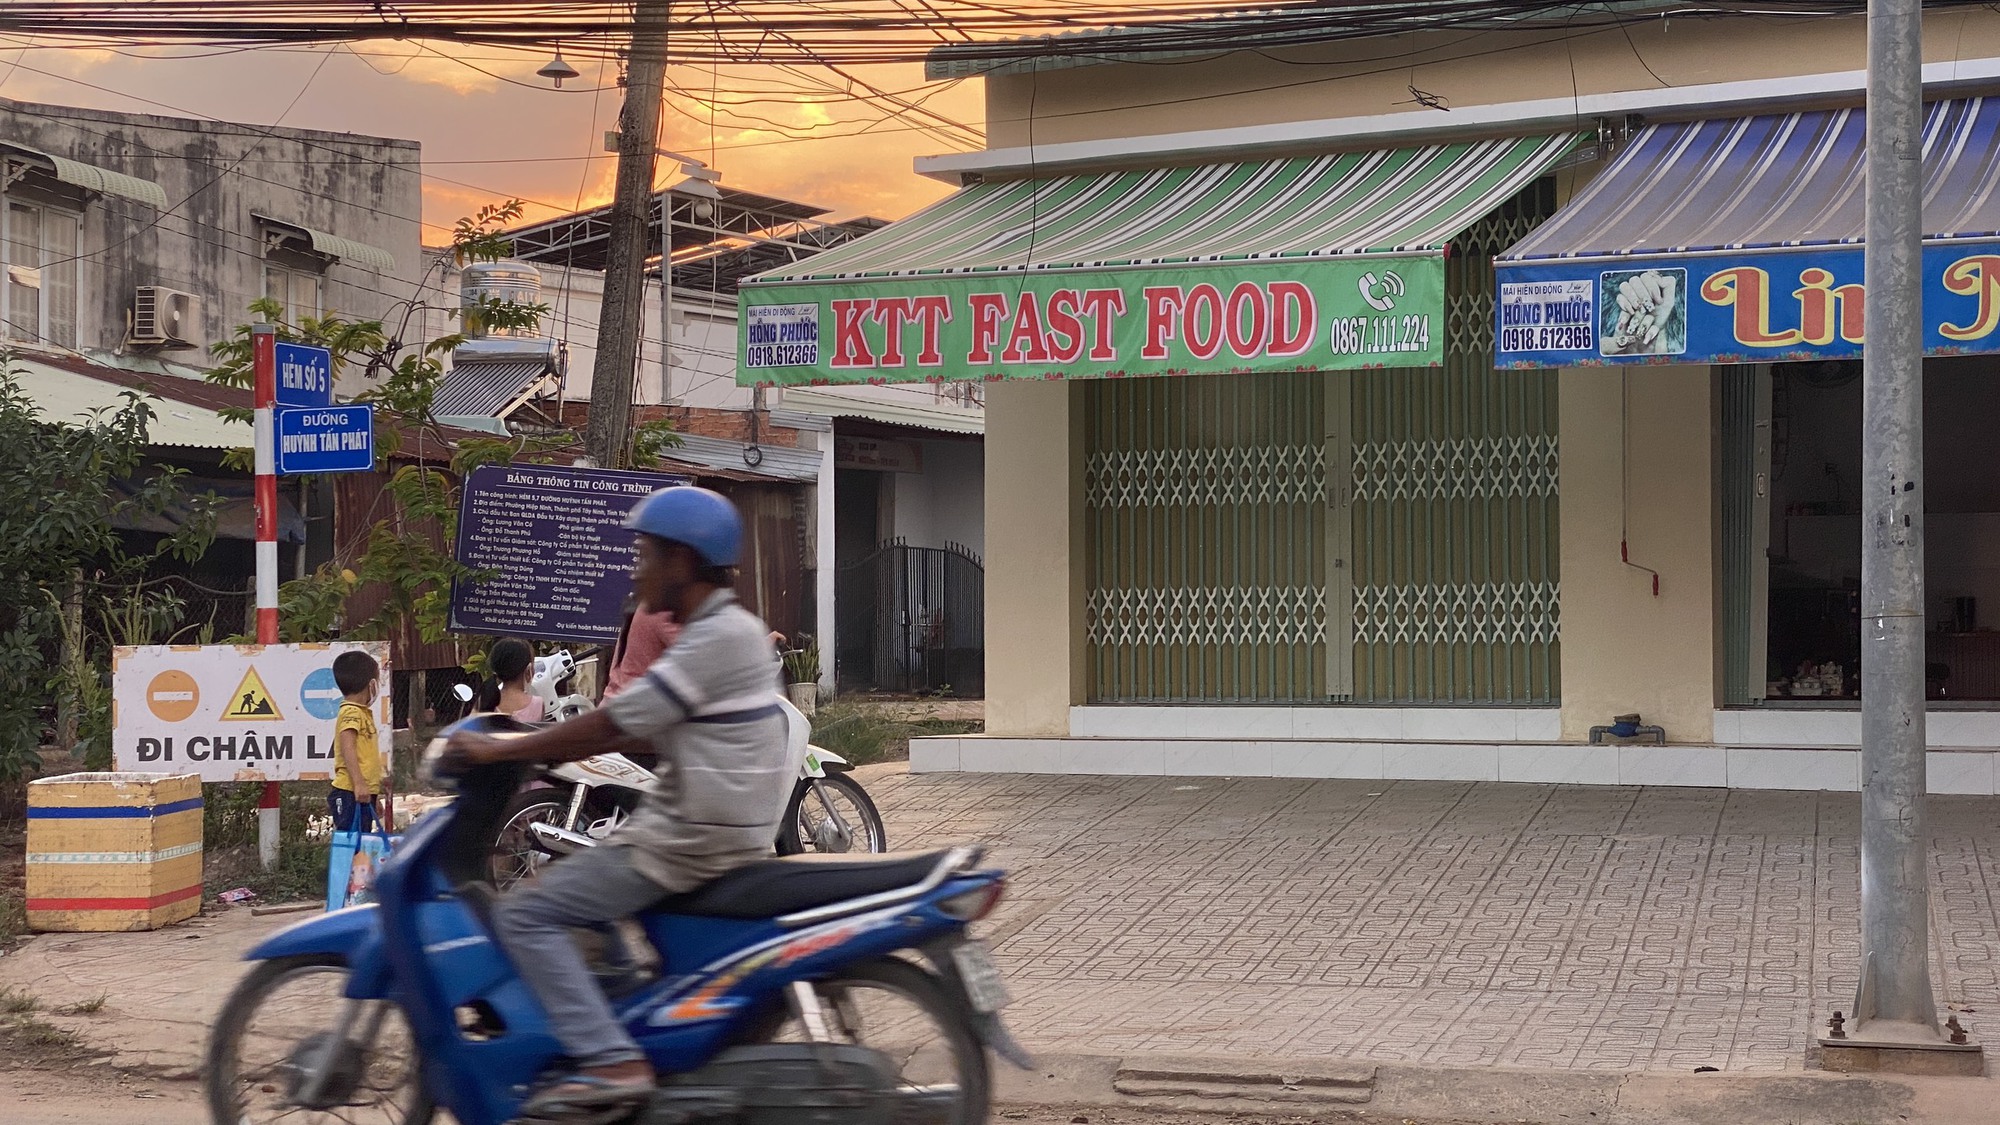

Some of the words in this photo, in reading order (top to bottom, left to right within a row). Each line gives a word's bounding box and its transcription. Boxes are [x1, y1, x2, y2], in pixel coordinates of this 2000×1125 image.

[1503, 286, 1515, 295] MÁI
[1517, 285, 1533, 295] HIÊN
[1543, 284, 1562, 296] ĐỘNG
[1503, 296, 1541, 326] HỒNG
[1544, 294, 1591, 324] PHƯỚC
[830, 294, 953, 368] KTT
[967, 287, 1128, 366] FAST
[1141, 281, 1318, 360] FOOD
[1330, 314, 1429, 356] 0867.111.224
[1503, 326, 1591, 350] 0918.612366
[748, 344, 817, 366] 0918.612366
[282, 353, 303, 389] HẺM
[304, 356, 318, 392] SỐ
[319, 368, 325, 392] 5
[302, 411, 348, 426] ĐƯỜNG
[283, 431, 317, 453] HUỲNH
[319, 428, 339, 452] TẤN
[342, 428, 368, 451] PHÁT
[506, 472, 533, 484] BẢNG
[536, 476, 570, 487] THÔNG
[573, 479, 589, 488] TIN
[592, 479, 618, 491] CÔNG
[622, 482, 652, 494] TRÌNH
[136, 737, 172, 762] ĐI
[186, 730, 293, 767] CHẬM
